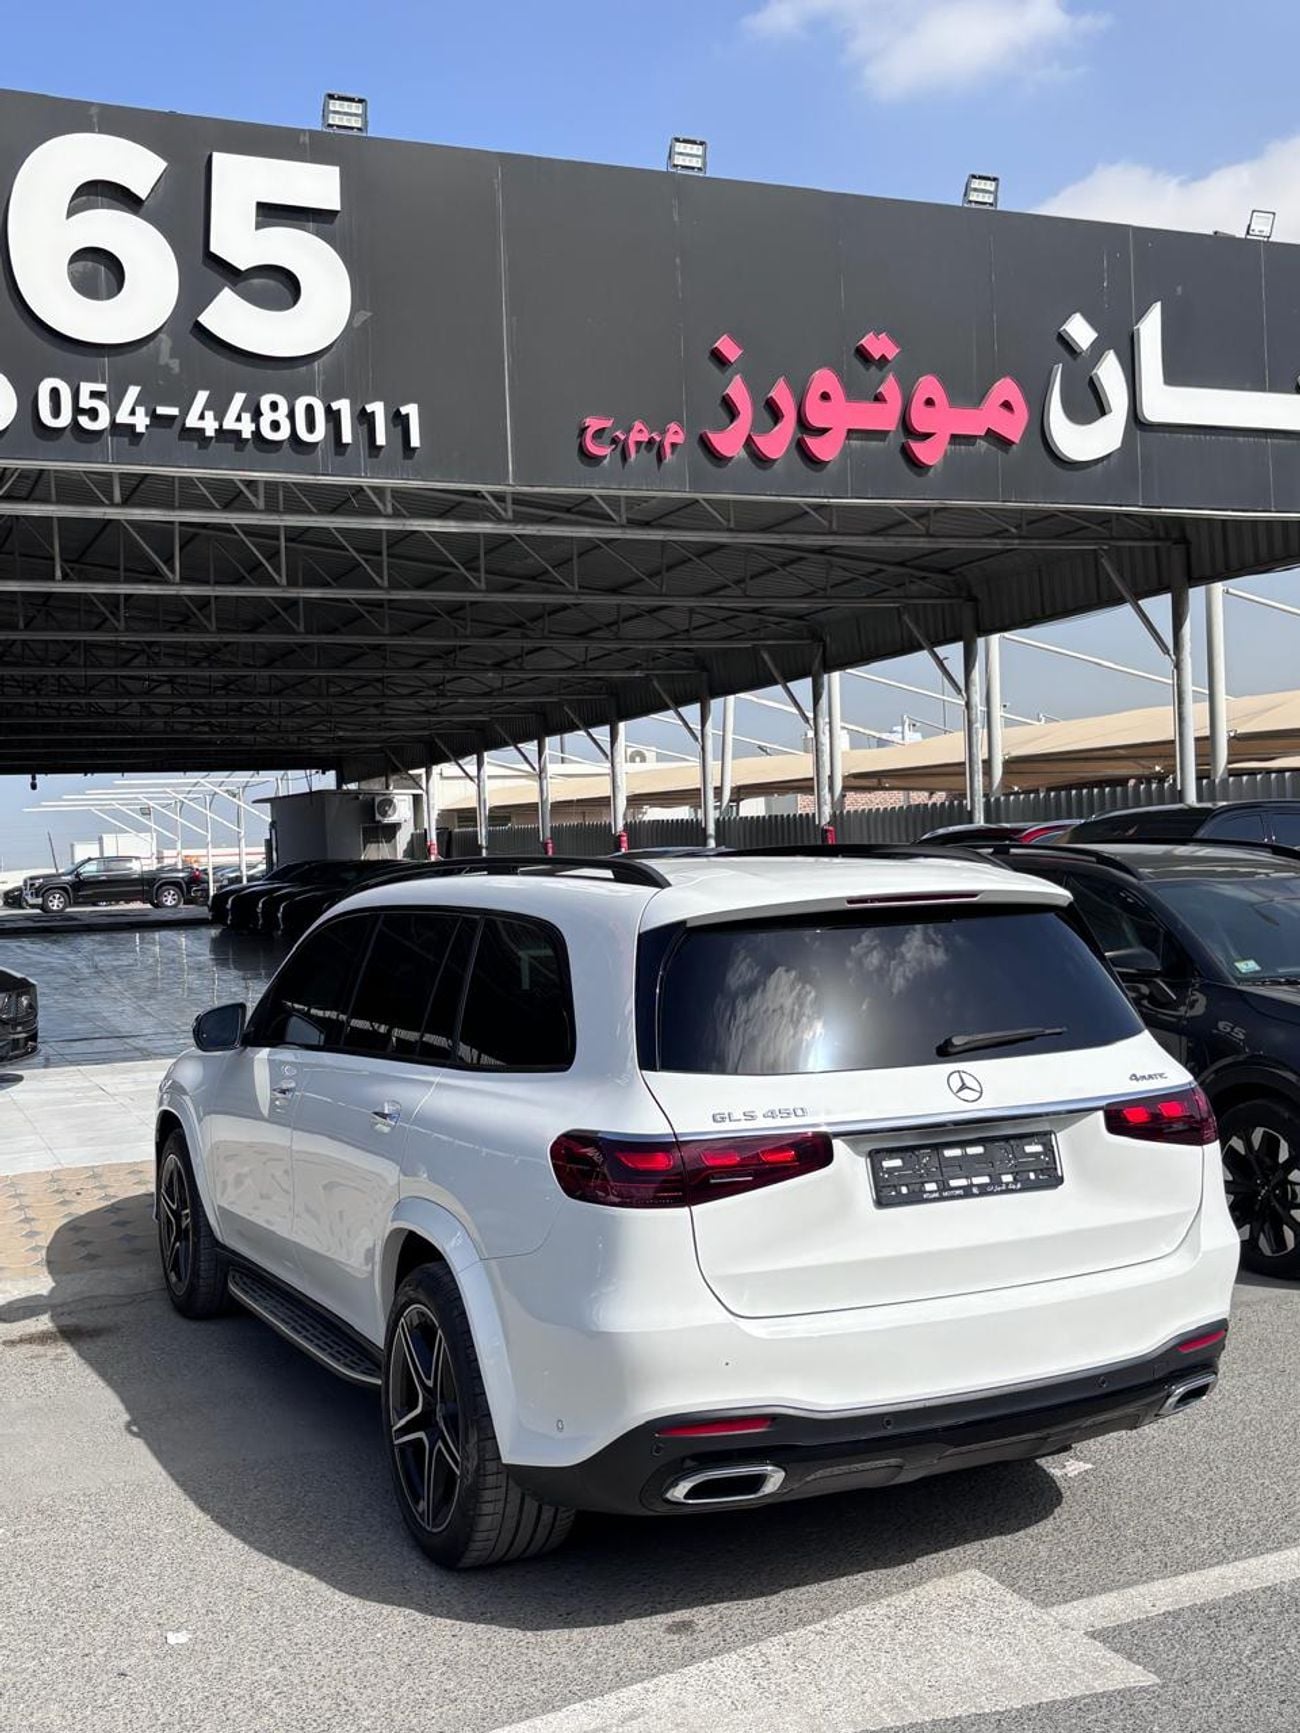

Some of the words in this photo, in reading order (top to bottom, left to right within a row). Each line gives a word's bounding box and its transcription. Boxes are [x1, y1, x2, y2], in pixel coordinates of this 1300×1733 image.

[7, 132, 353, 358] 65
[37, 377, 422, 449] 054-4480111
[702, 331, 1030, 468] موتورز
[1045, 301, 1300, 463] ان
[711, 1110, 759, 1124] GLS
[762, 1106, 809, 1120] 450
